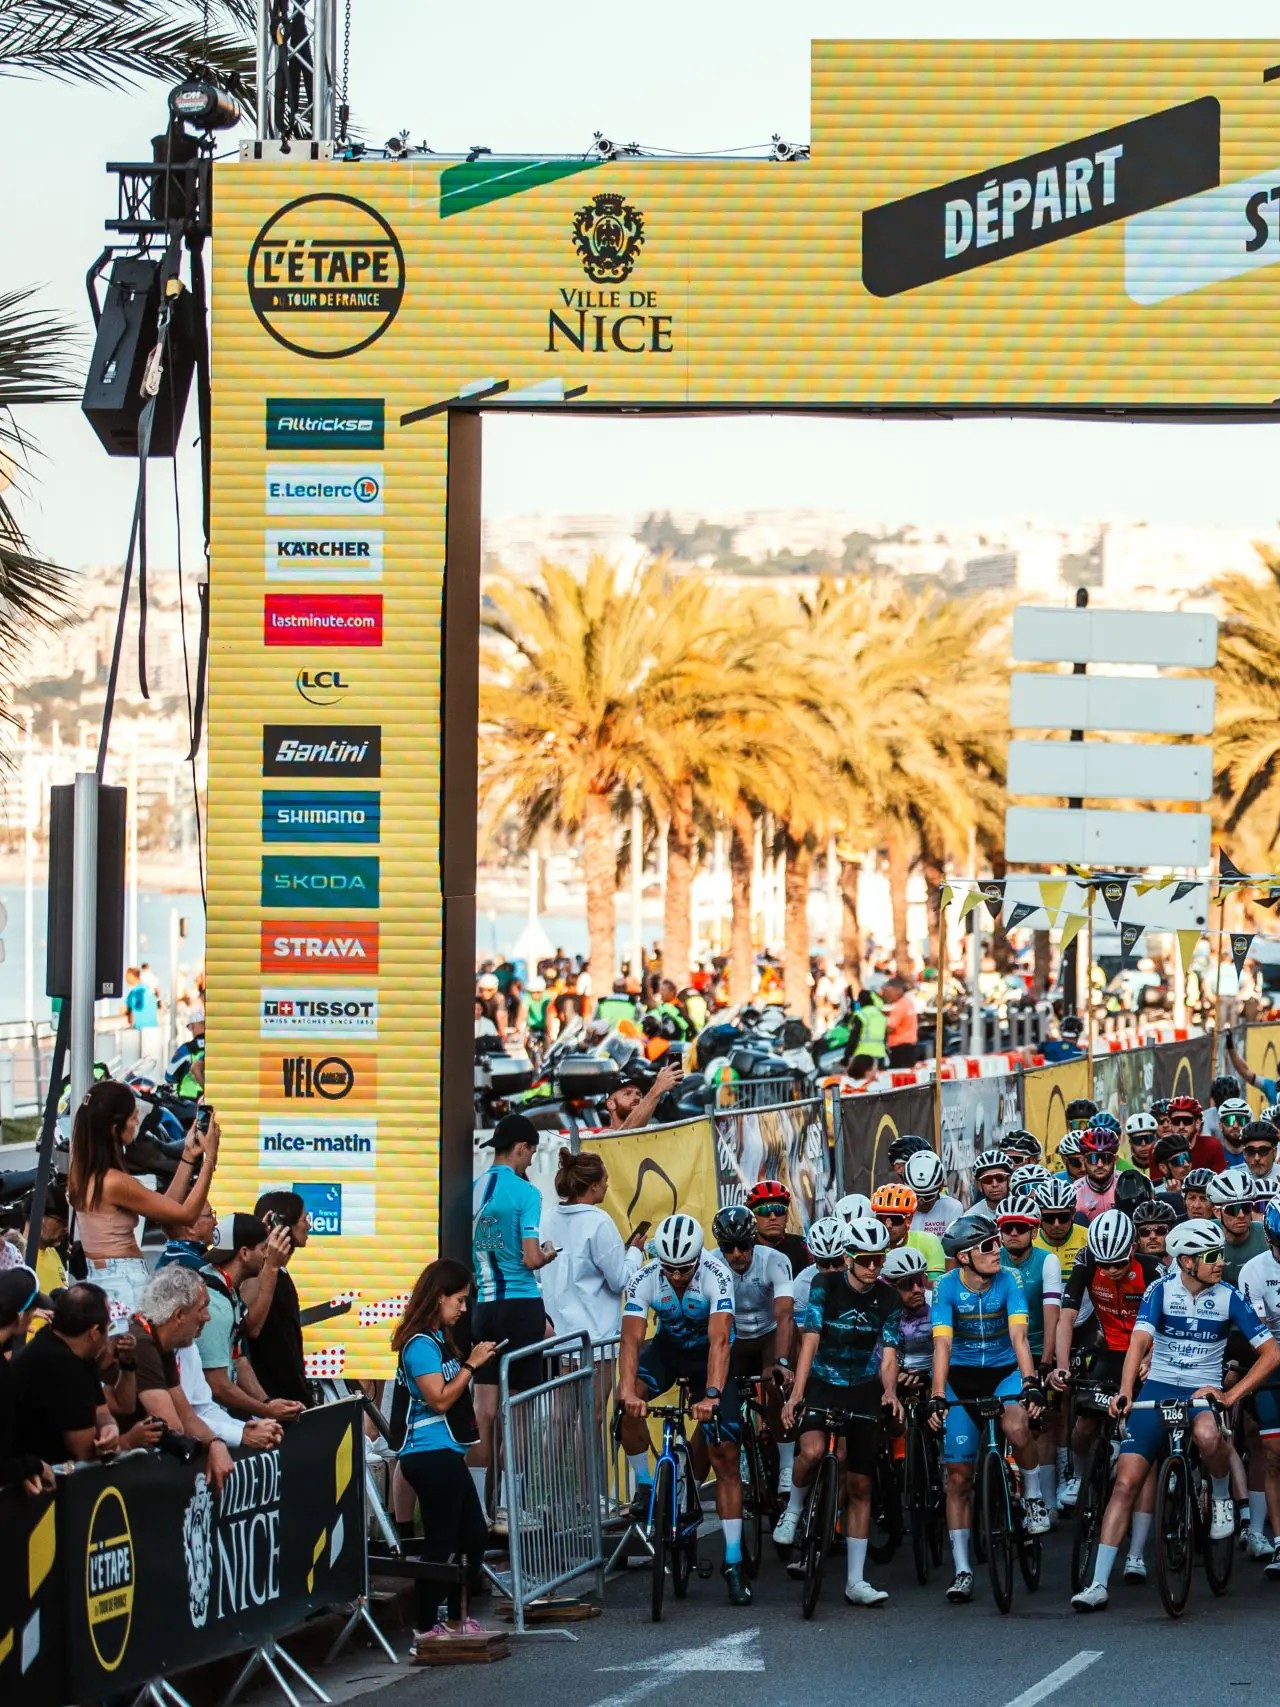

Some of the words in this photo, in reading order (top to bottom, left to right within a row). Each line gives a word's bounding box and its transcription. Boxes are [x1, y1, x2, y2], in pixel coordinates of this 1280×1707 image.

[944, 143, 1124, 260] DÉPART
[264, 240, 389, 283] L'ÉTAPE
[287, 293, 317, 306] TOUR
[319, 294, 334, 306] DE
[336, 293, 380, 306] FRANCE
[559, 287, 621, 308] VILLE
[629, 290, 657, 308] DE
[544, 308, 674, 353] NICE
[277, 417, 358, 431] Alltricks
[270, 483, 352, 497] E.Leclerc
[277, 541, 370, 557] KÄRCHER
[272, 613, 375, 628] lastminute.com
[302, 671, 349, 689] LCL
[275, 740, 370, 763] Santini
[277, 809, 366, 824] SHIMANO
[273, 937, 366, 958] STRAVA
[296, 1001, 374, 1017] TISSOT
[282, 1056, 355, 1100] VÉLO
[263, 1132, 371, 1152] nice-matin
[1164, 1325, 1219, 1341] Zanello
[1167, 1340, 1209, 1355] Guérin
[1162, 1408, 1184, 1421] 1286
[260, 1449, 282, 1506] DE
[90, 1540, 130, 1593] L'ÉTAPE
[217, 1509, 281, 1619] NICE
